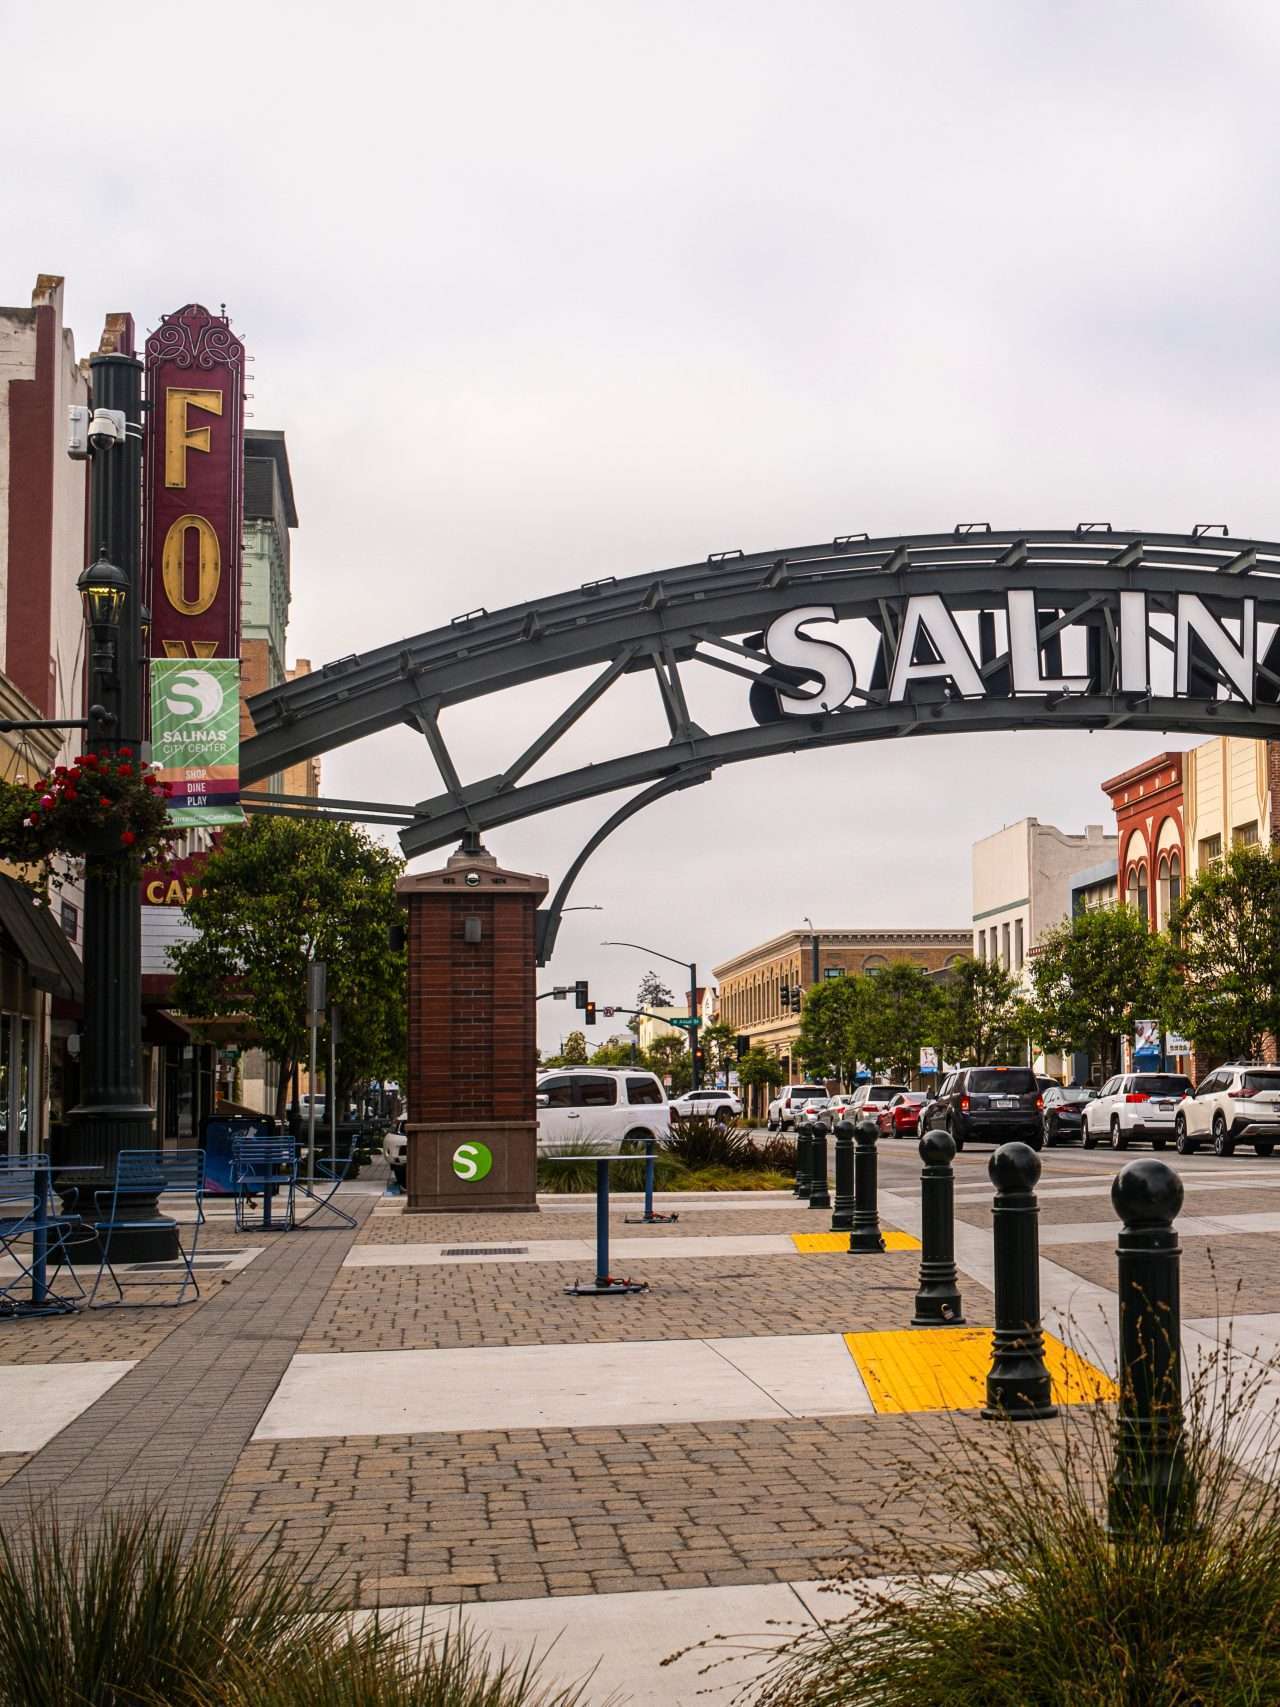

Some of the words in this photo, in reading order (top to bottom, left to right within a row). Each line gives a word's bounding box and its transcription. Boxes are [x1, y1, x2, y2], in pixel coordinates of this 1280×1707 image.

[162, 386, 224, 659] FO
[163, 730, 227, 743] SALINAS
[163, 744, 186, 754] CITY
[188, 742, 227, 753] CENTER
[185, 769, 207, 780] SHOP
[187, 782, 206, 793] DINE
[187, 795, 208, 806] PLAY
